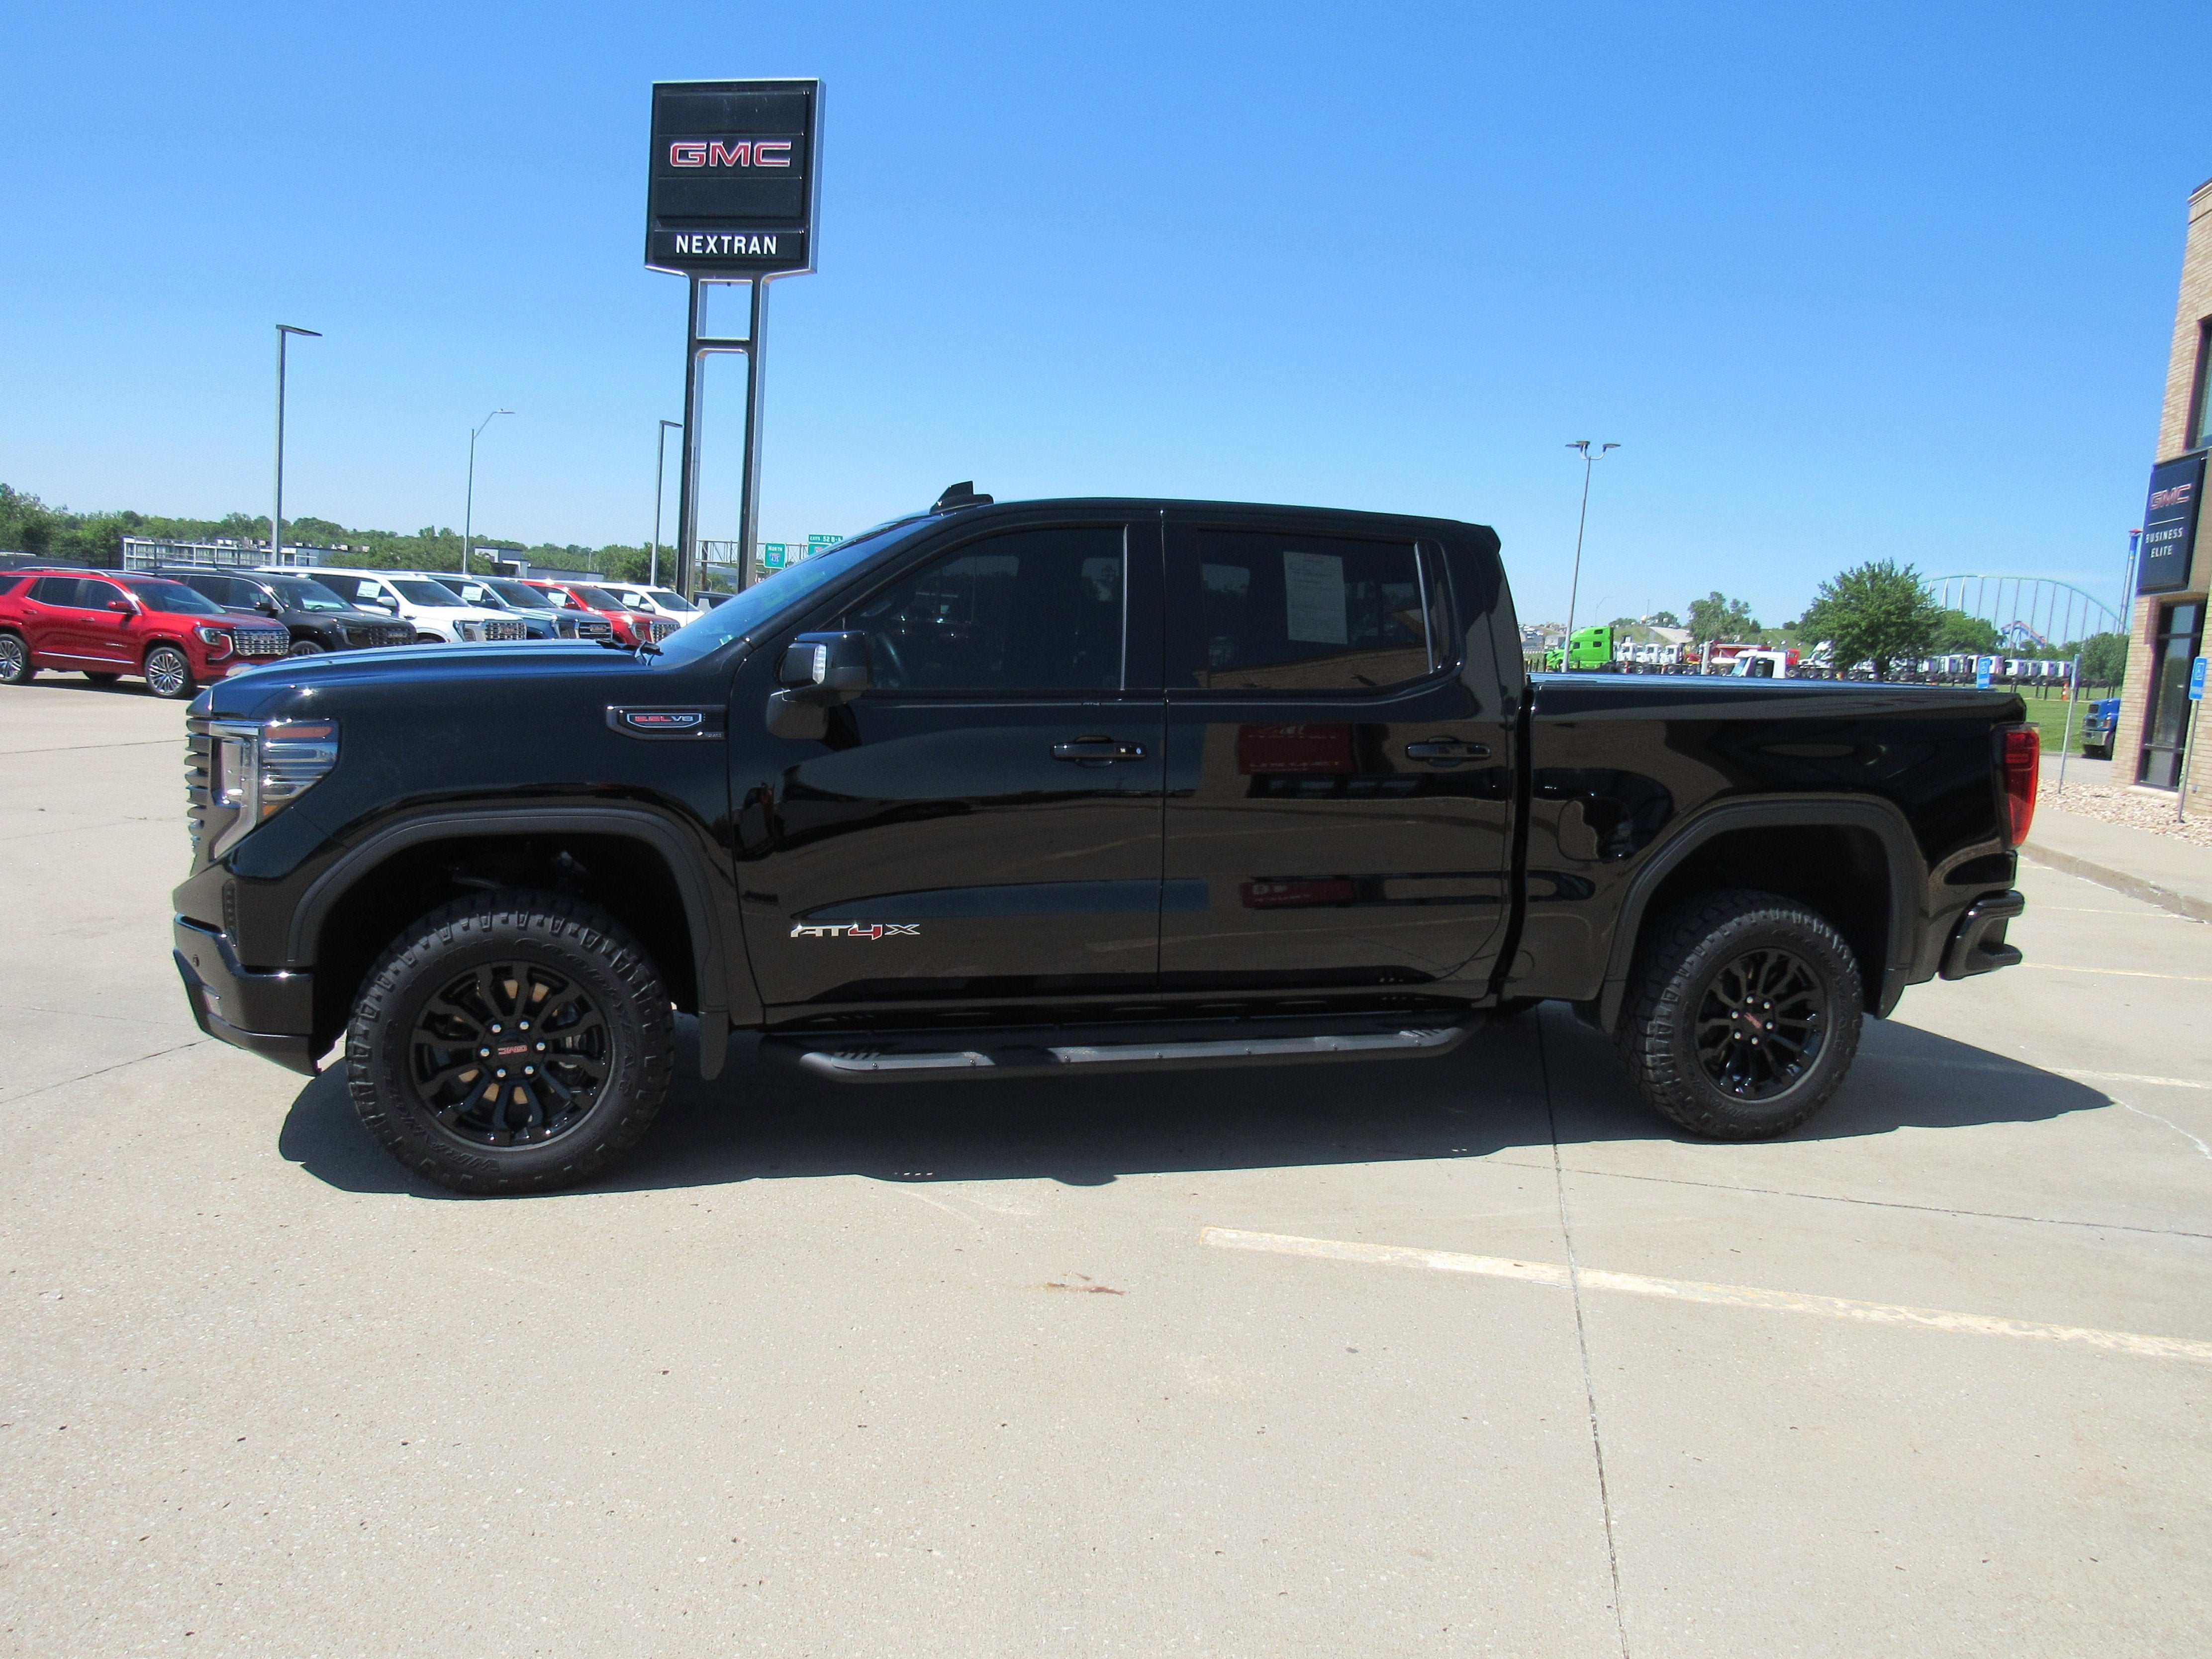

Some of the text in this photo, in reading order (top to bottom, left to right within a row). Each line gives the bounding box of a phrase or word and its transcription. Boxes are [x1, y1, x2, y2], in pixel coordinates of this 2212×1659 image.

[670, 141, 791, 167] GMC
[675, 235, 777, 255] NEXTRAN
[2150, 483, 2192, 510] GMC
[2145, 527, 2184, 544] BUSINESS
[2150, 545, 2173, 558] ELITE
[790, 922, 920, 941] AT4X
[498, 1045, 527, 1055] GMC
